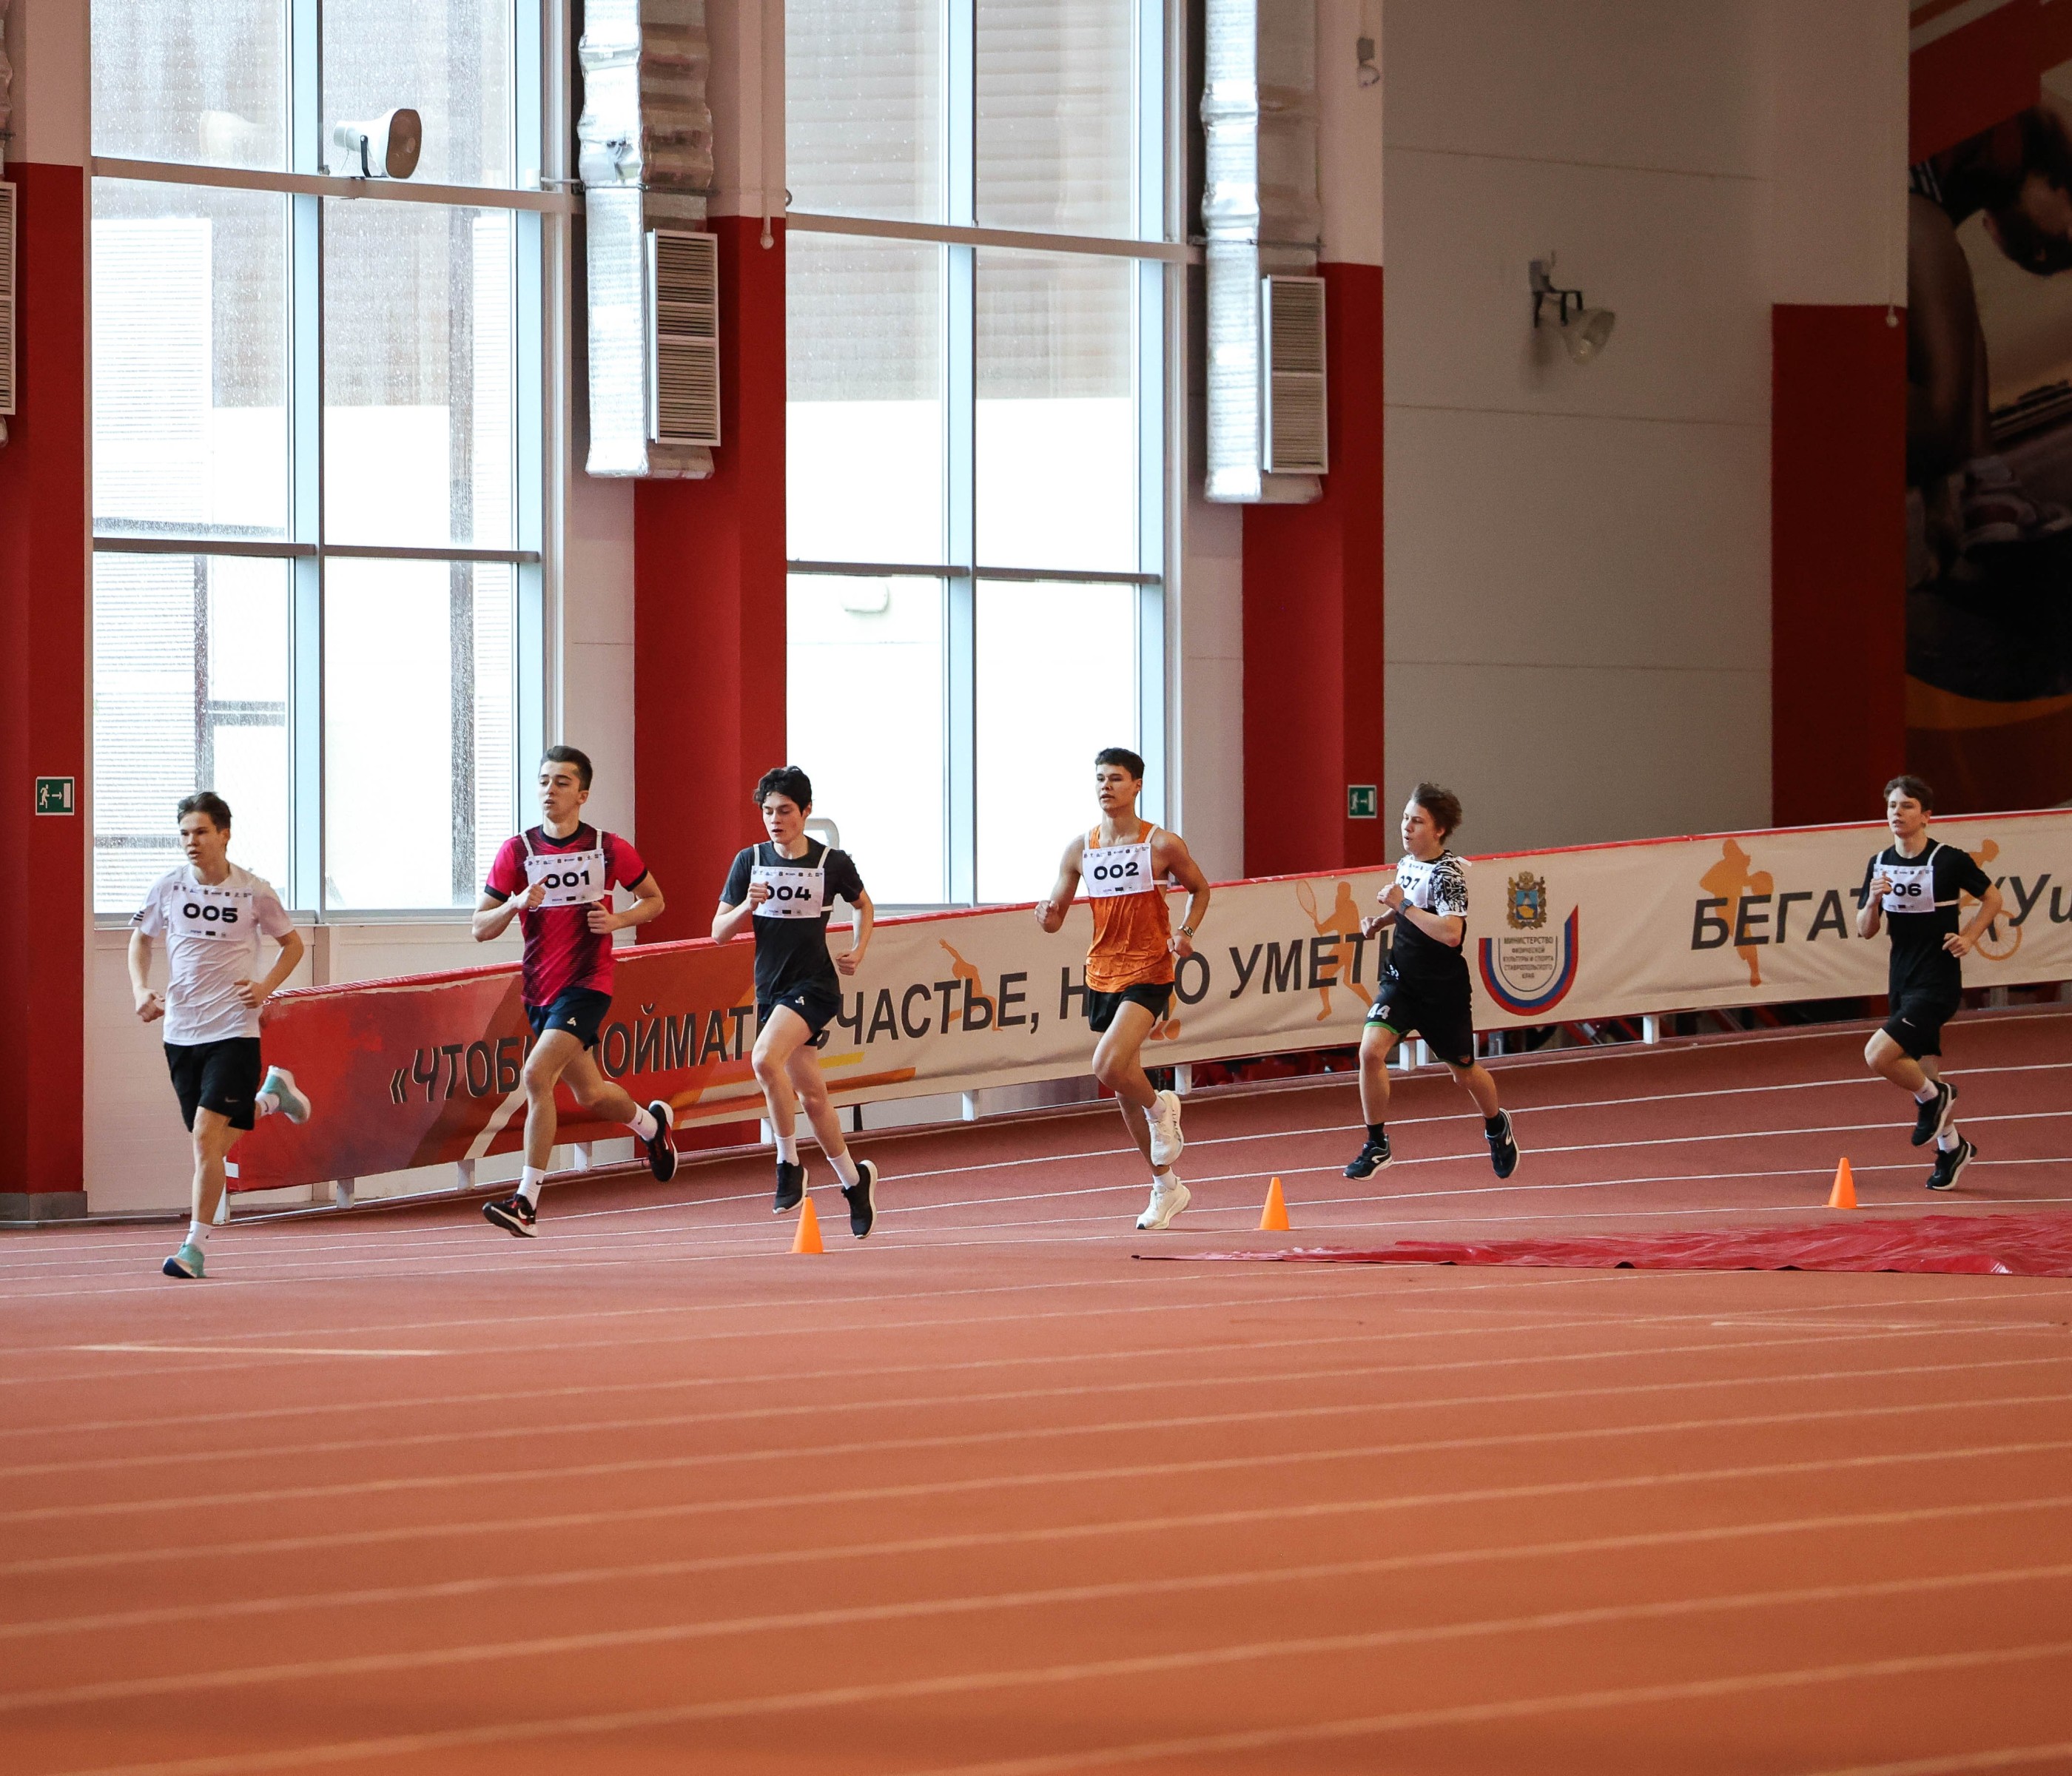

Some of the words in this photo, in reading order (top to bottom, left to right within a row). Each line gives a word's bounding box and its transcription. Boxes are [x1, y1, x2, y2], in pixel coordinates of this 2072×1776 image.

[545, 870, 590, 889] 001
[1094, 862, 1139, 880] 002
[1884, 883, 1922, 896] 06
[183, 903, 238, 924] 005
[593, 1003, 766, 1078] ОЙМАТ
[817, 972, 1040, 1050] ЧАСТЬЕ,
[1060, 951, 1210, 1020] НО
[1690, 888, 1891, 950] БЕГА
